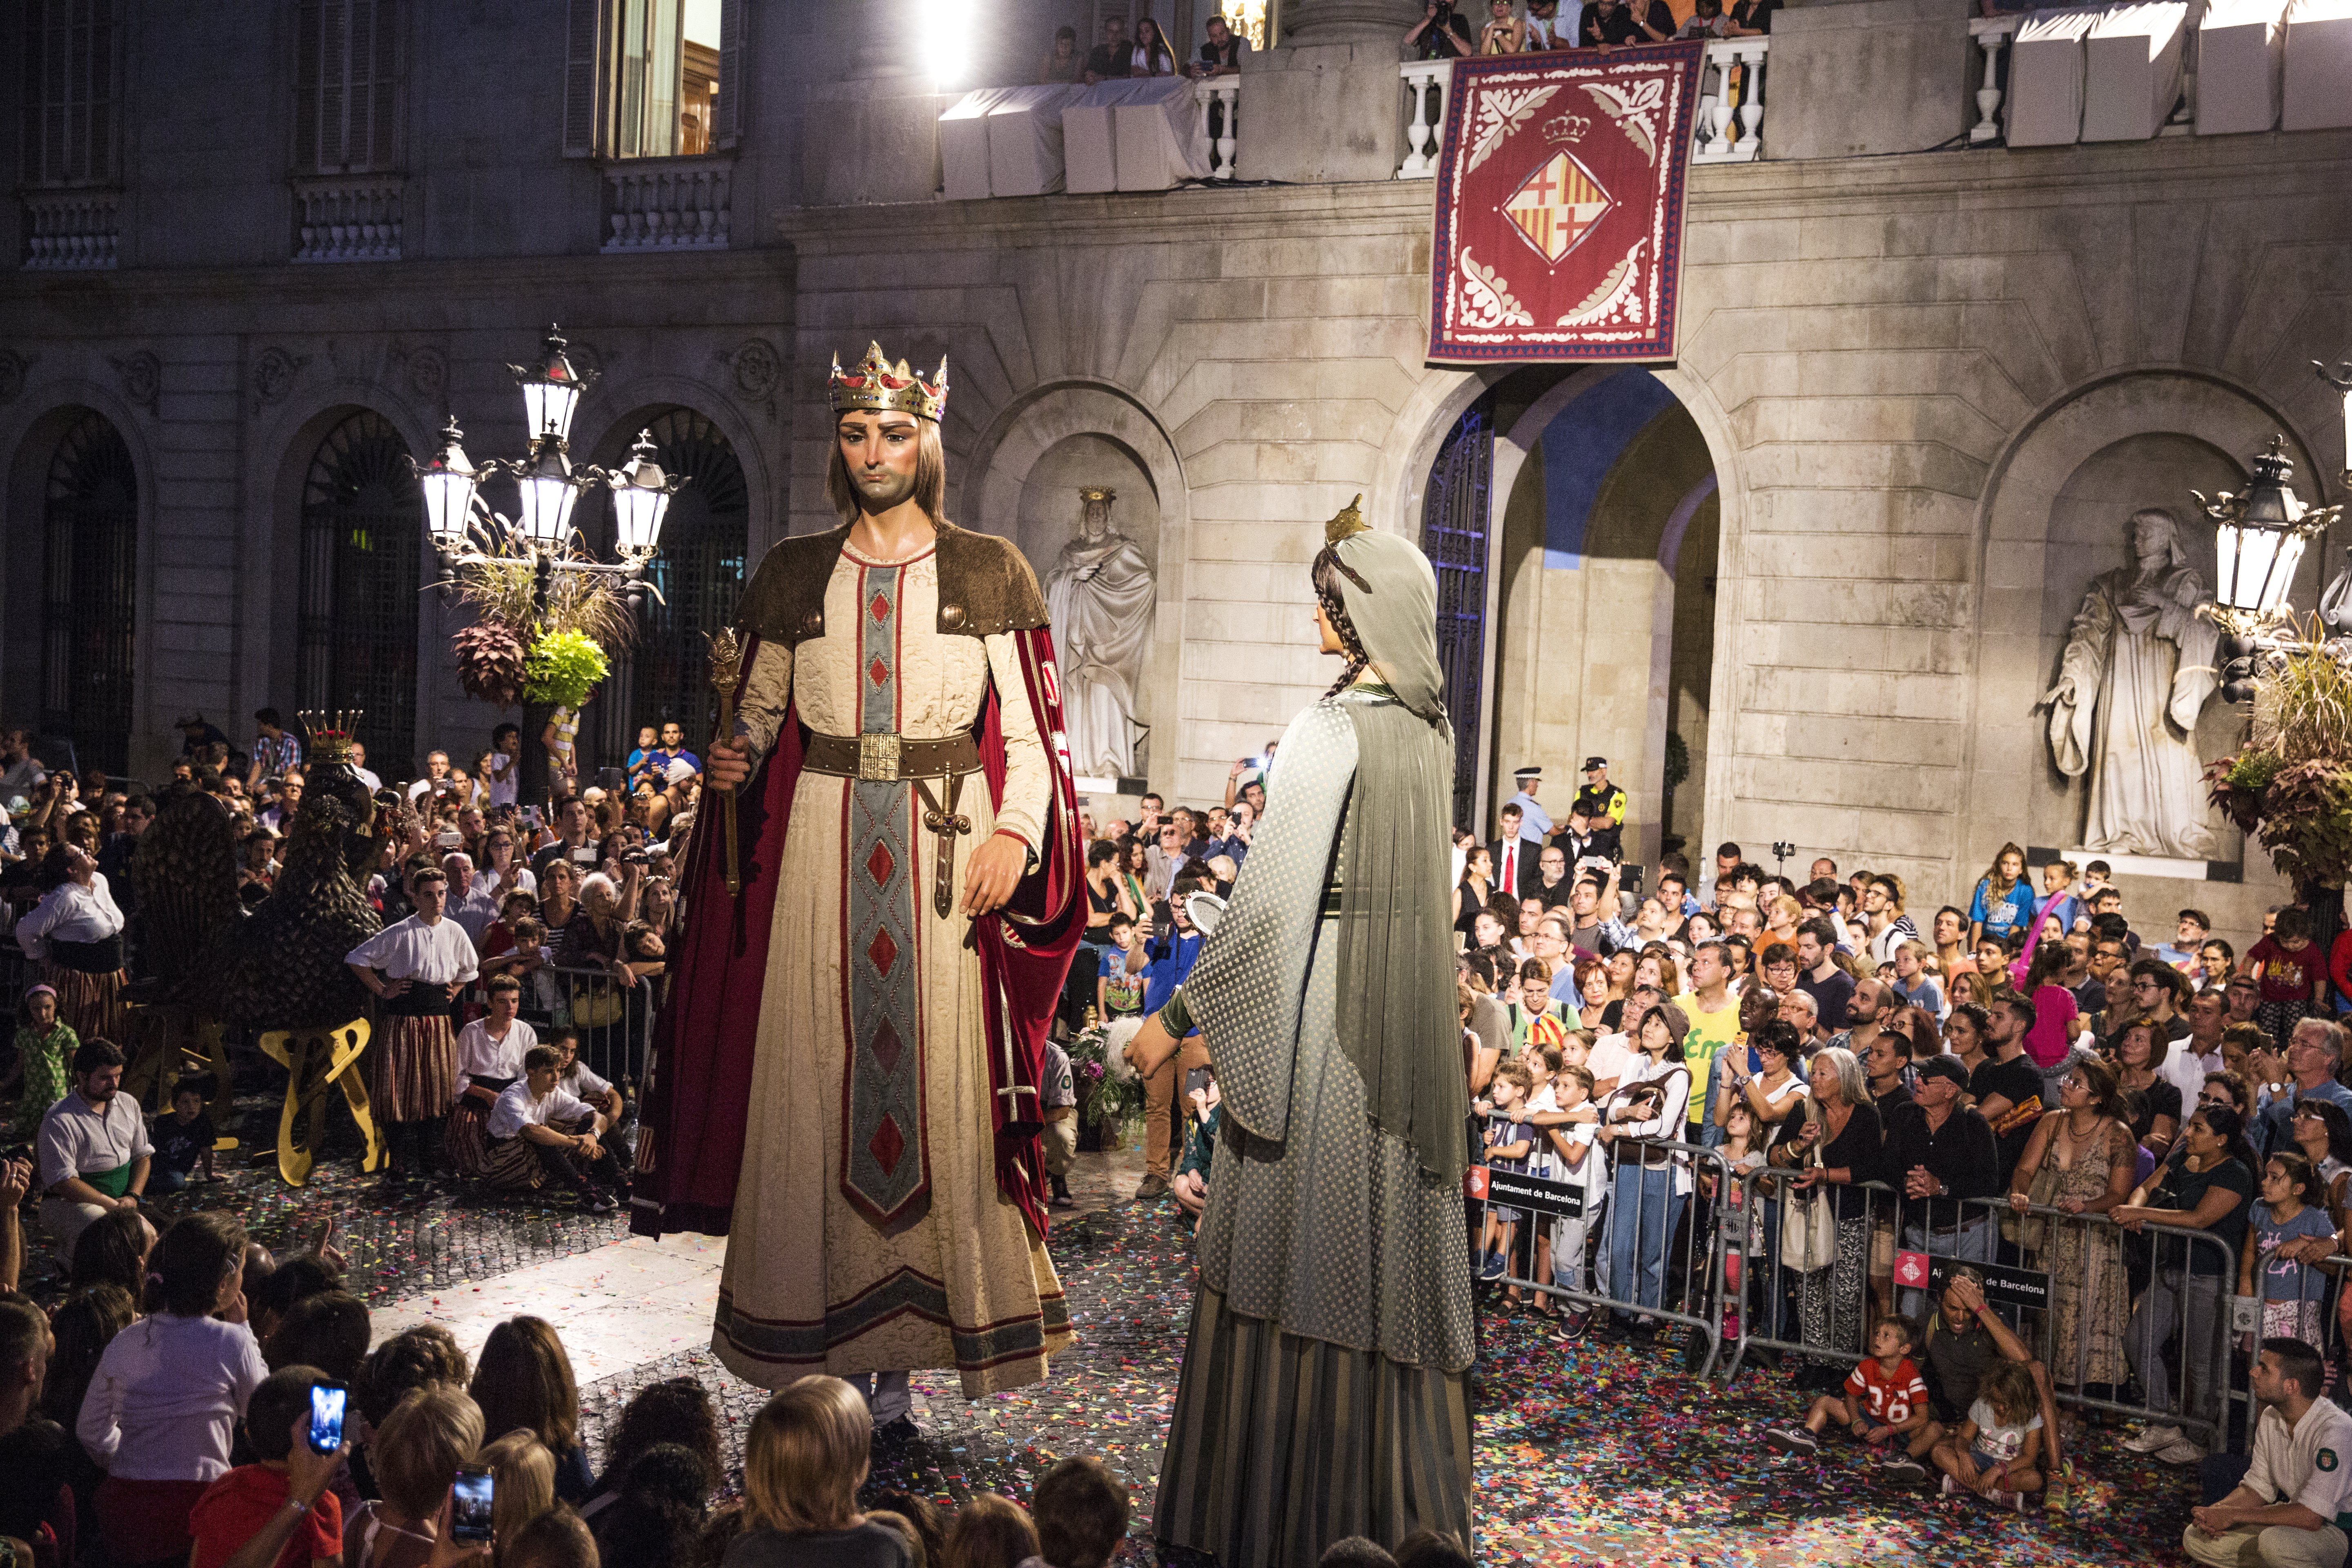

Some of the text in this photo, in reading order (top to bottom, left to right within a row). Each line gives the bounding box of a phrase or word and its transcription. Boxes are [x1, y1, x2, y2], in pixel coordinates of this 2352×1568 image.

[1491, 1180, 1580, 1205] Ajuntament de Barcelona
[1986, 1278, 2045, 1295] de Barcelona
